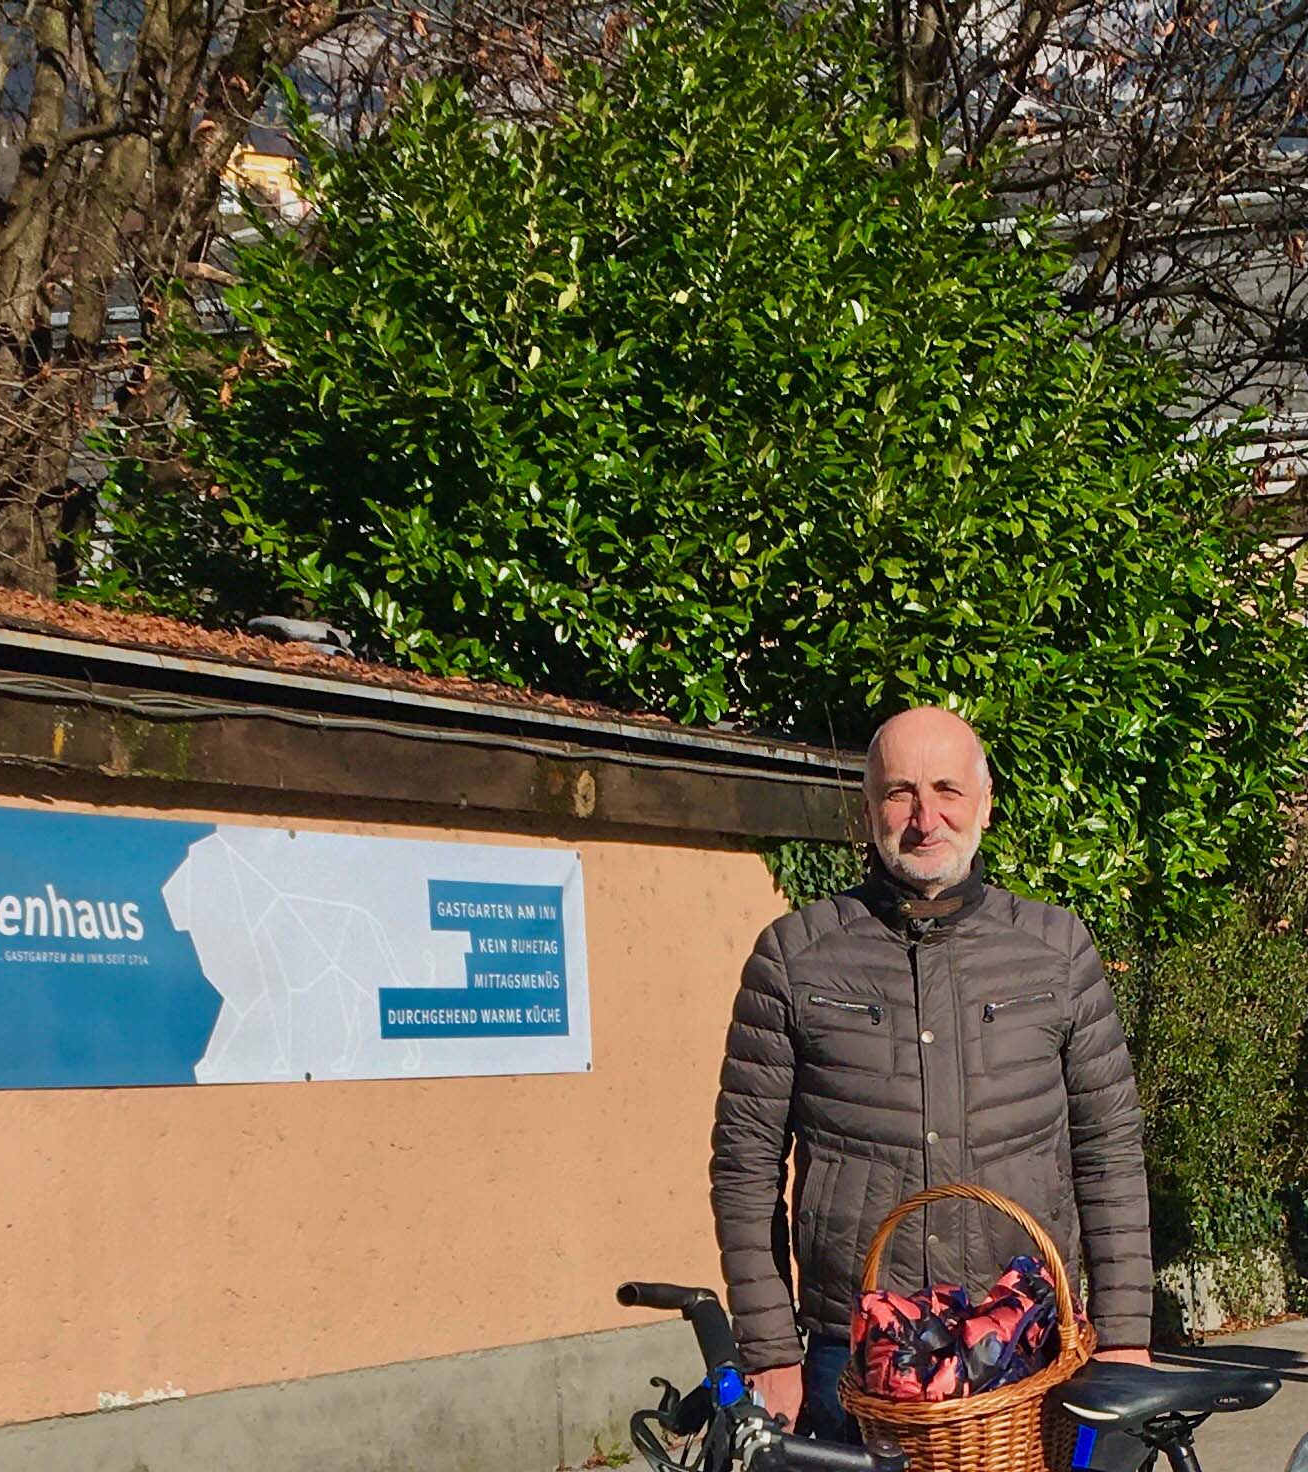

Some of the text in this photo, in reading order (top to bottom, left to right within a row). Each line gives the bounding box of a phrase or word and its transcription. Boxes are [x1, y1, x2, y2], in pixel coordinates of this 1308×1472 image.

[437, 901, 557, 920] GASTGARTEN AM INN
[478, 938, 558, 955] KEIN RUHETAG
[3, 950, 67, 964] GASTGARTEN
[69, 952, 85, 964] AM
[474, 971, 560, 990] MITTAGSMENÜS
[388, 1004, 562, 1025] DURCHGEHEND WARME KÜCHE
